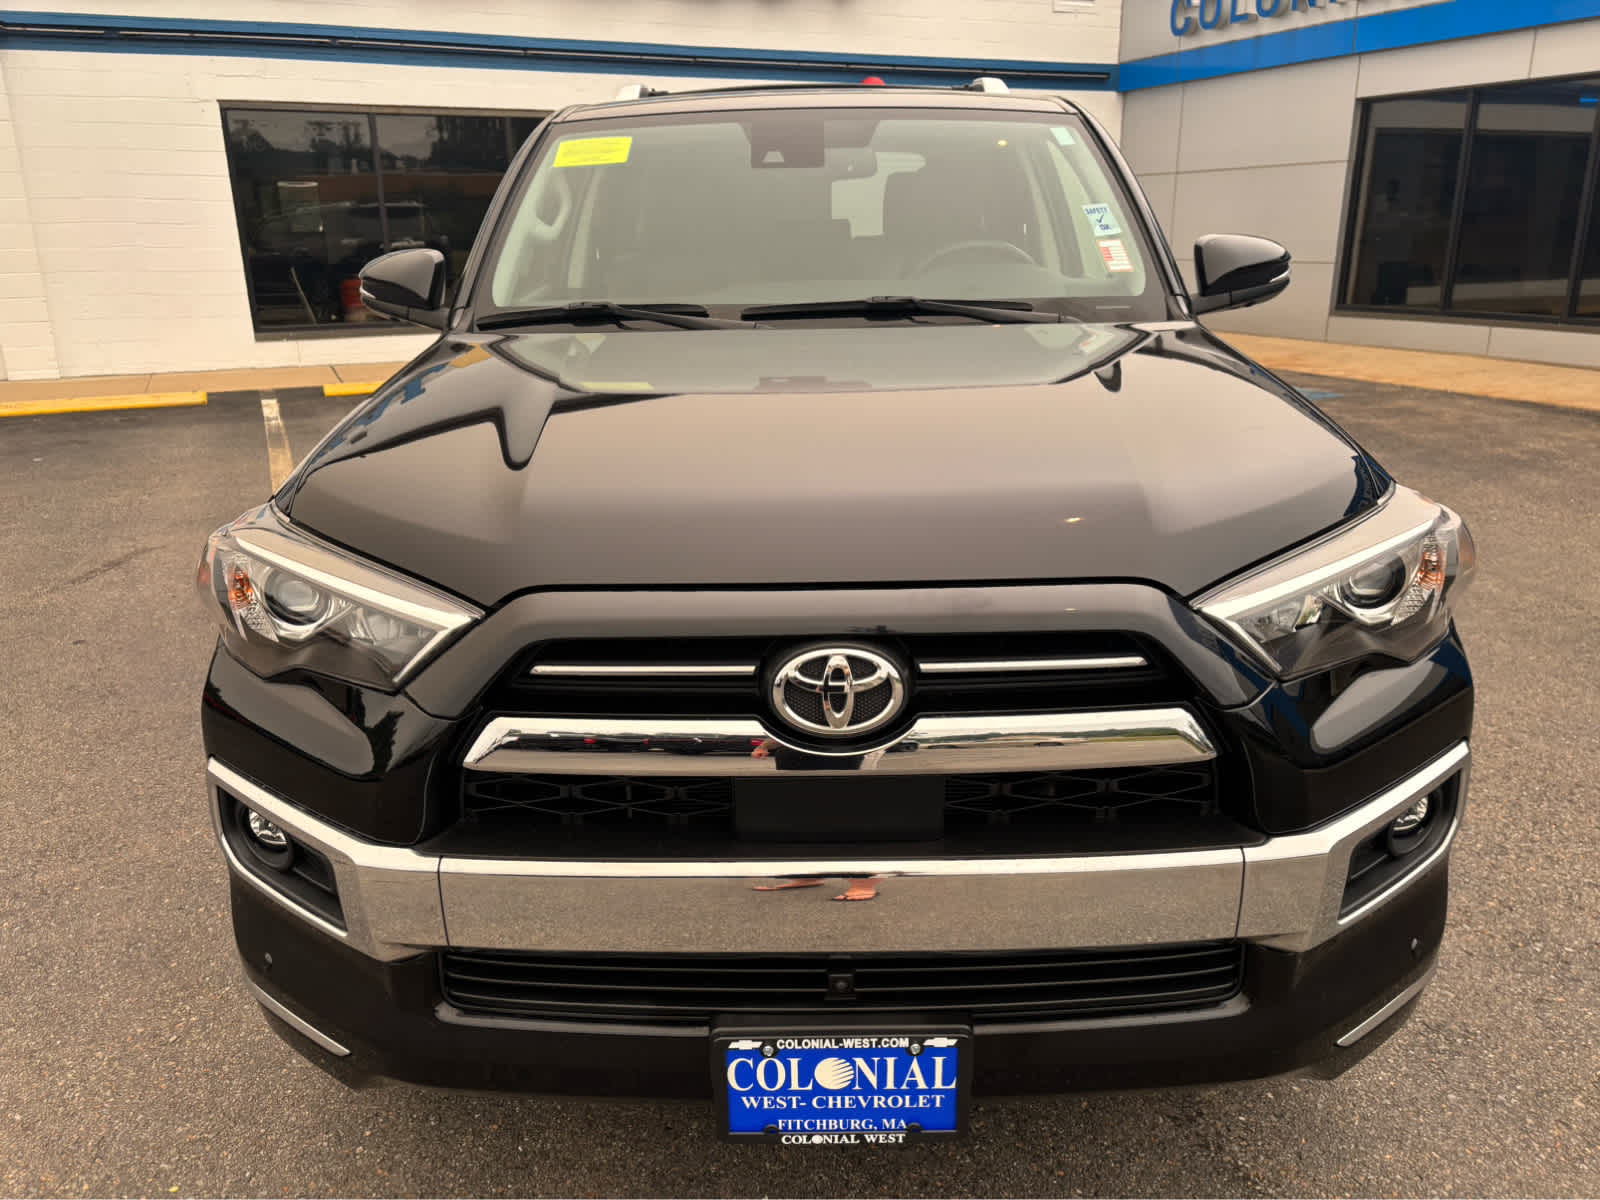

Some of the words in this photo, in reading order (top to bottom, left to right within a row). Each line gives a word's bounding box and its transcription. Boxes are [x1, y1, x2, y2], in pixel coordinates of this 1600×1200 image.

[776, 1038, 909, 1050] COLONIAL-WEST.COM
[727, 1056, 957, 1092] COLONIAL
[811, 1094, 945, 1109] CHEVROLET
[777, 1118, 879, 1131] FITCHBURG,
[882, 1117, 908, 1130] MA
[781, 1134, 859, 1145] COLONIAL
[864, 1133, 906, 1144] WEST
